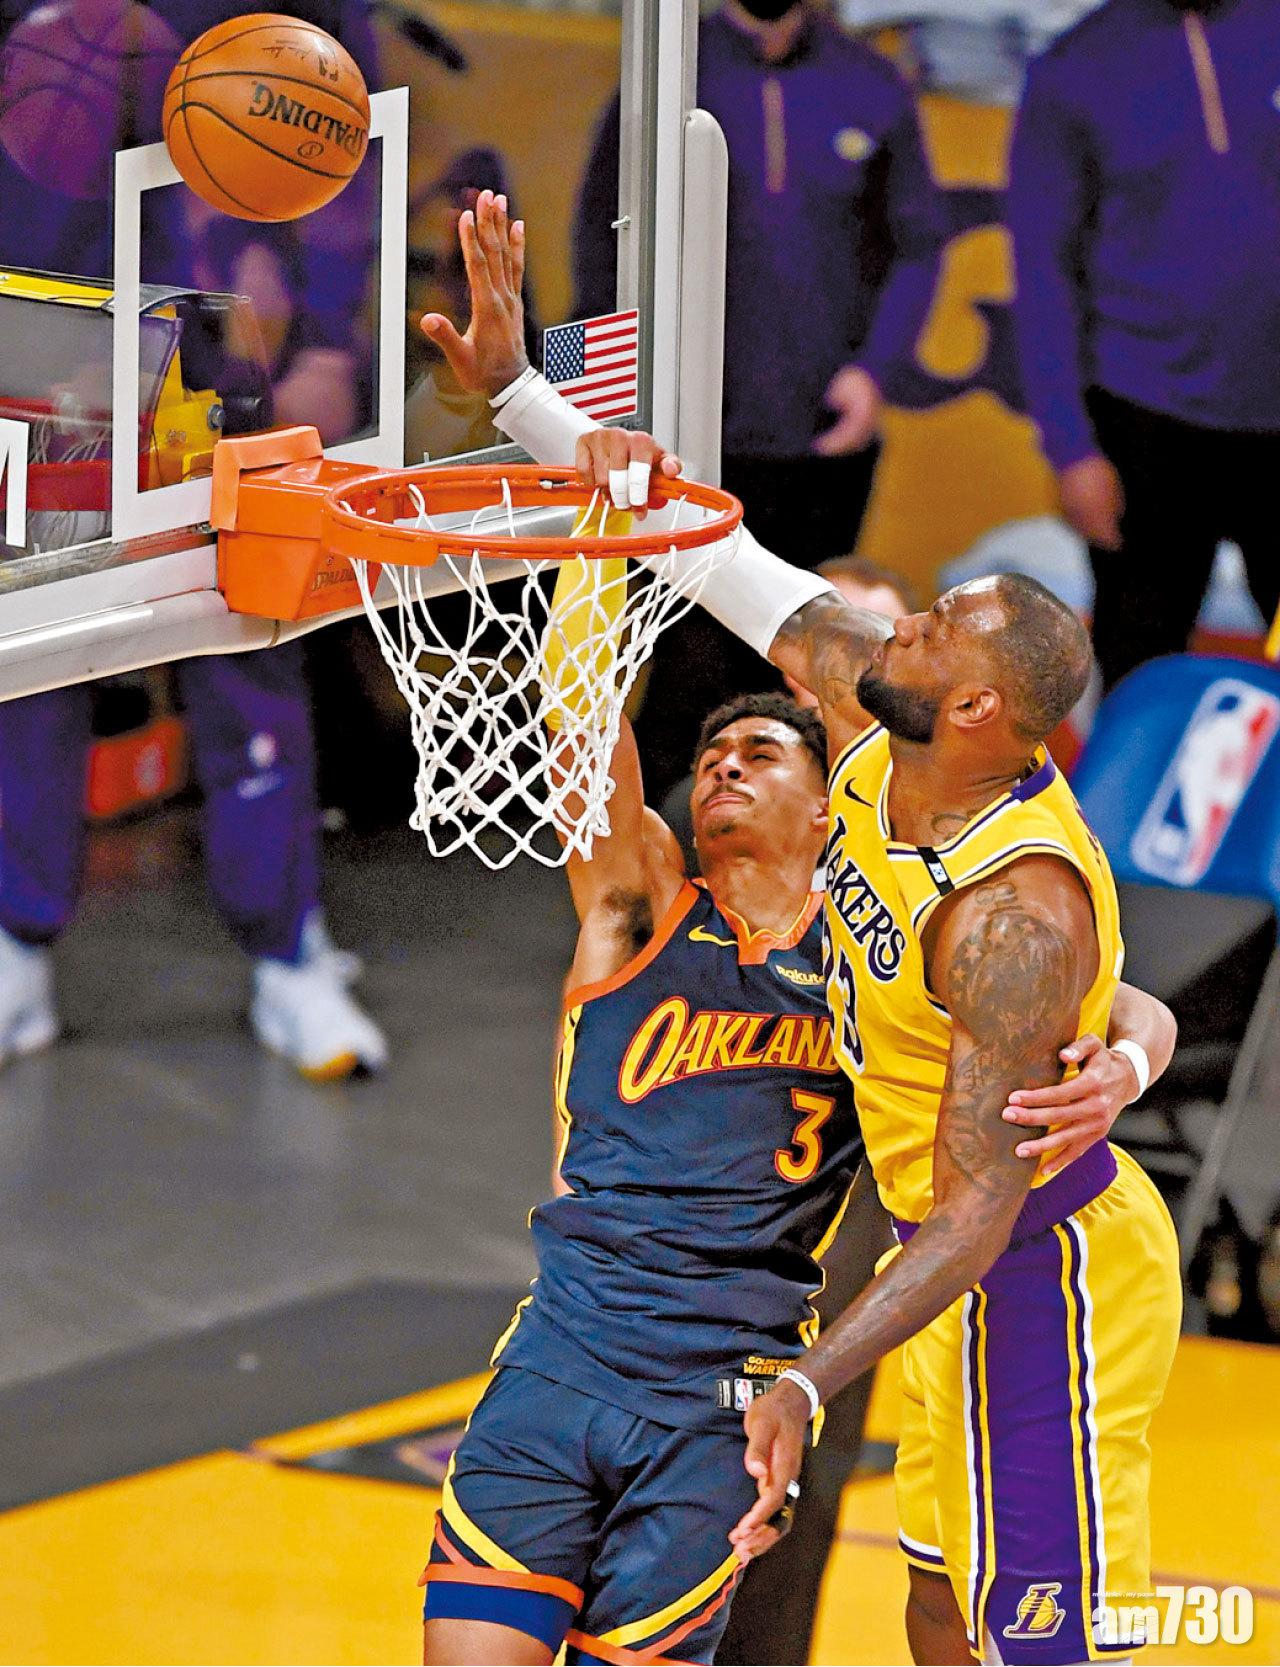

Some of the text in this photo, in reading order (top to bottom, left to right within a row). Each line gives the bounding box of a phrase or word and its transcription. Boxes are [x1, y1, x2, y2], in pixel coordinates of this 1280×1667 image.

[775, 965, 826, 986] Rakute
[775, 1088, 836, 1182] 3
[743, 1362, 788, 1376] WARRIO
